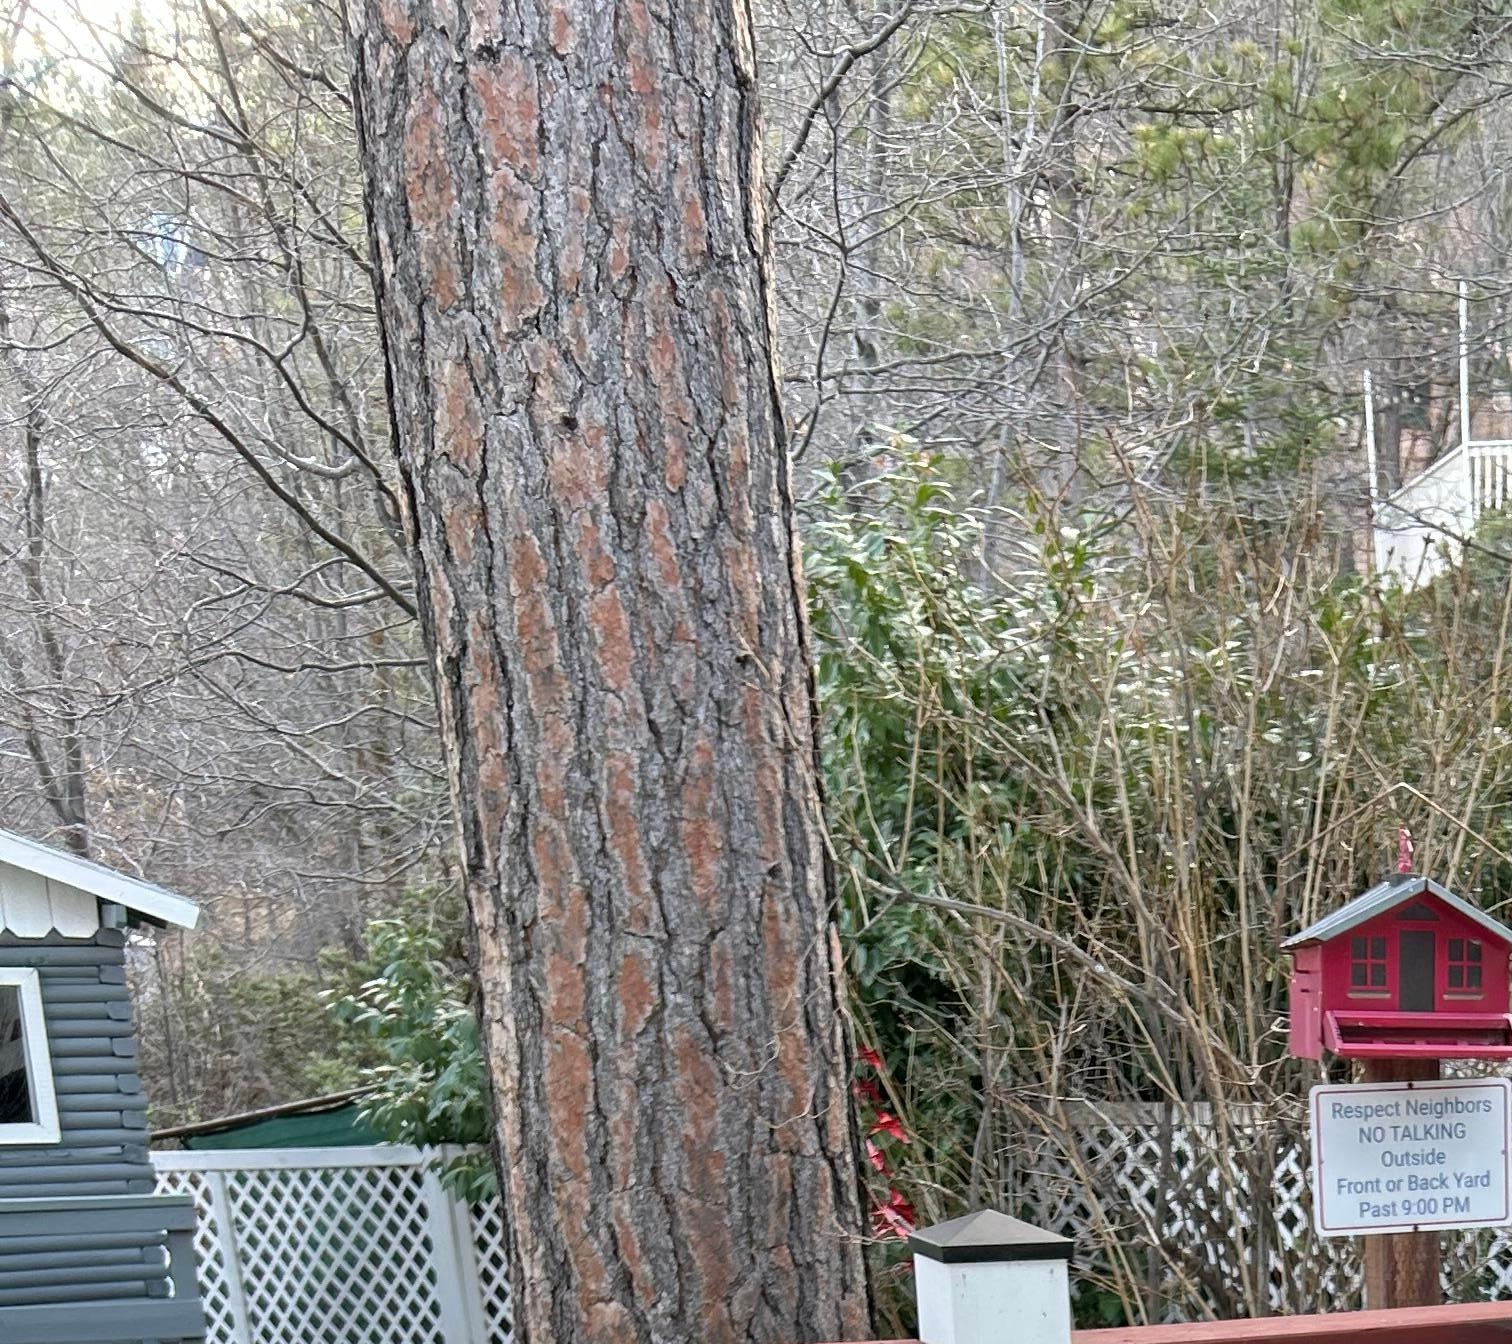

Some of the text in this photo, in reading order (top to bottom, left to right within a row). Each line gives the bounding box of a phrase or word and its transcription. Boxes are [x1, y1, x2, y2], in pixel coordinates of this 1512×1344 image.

[1332, 1097, 1492, 1121] Respect Neighbors
[1359, 1123, 1467, 1143] NO TALKING
[1381, 1149, 1446, 1167] Outside
[1337, 1170, 1491, 1195] Front or Back Yard
[1359, 1197, 1470, 1218] Past 9:00 PM
